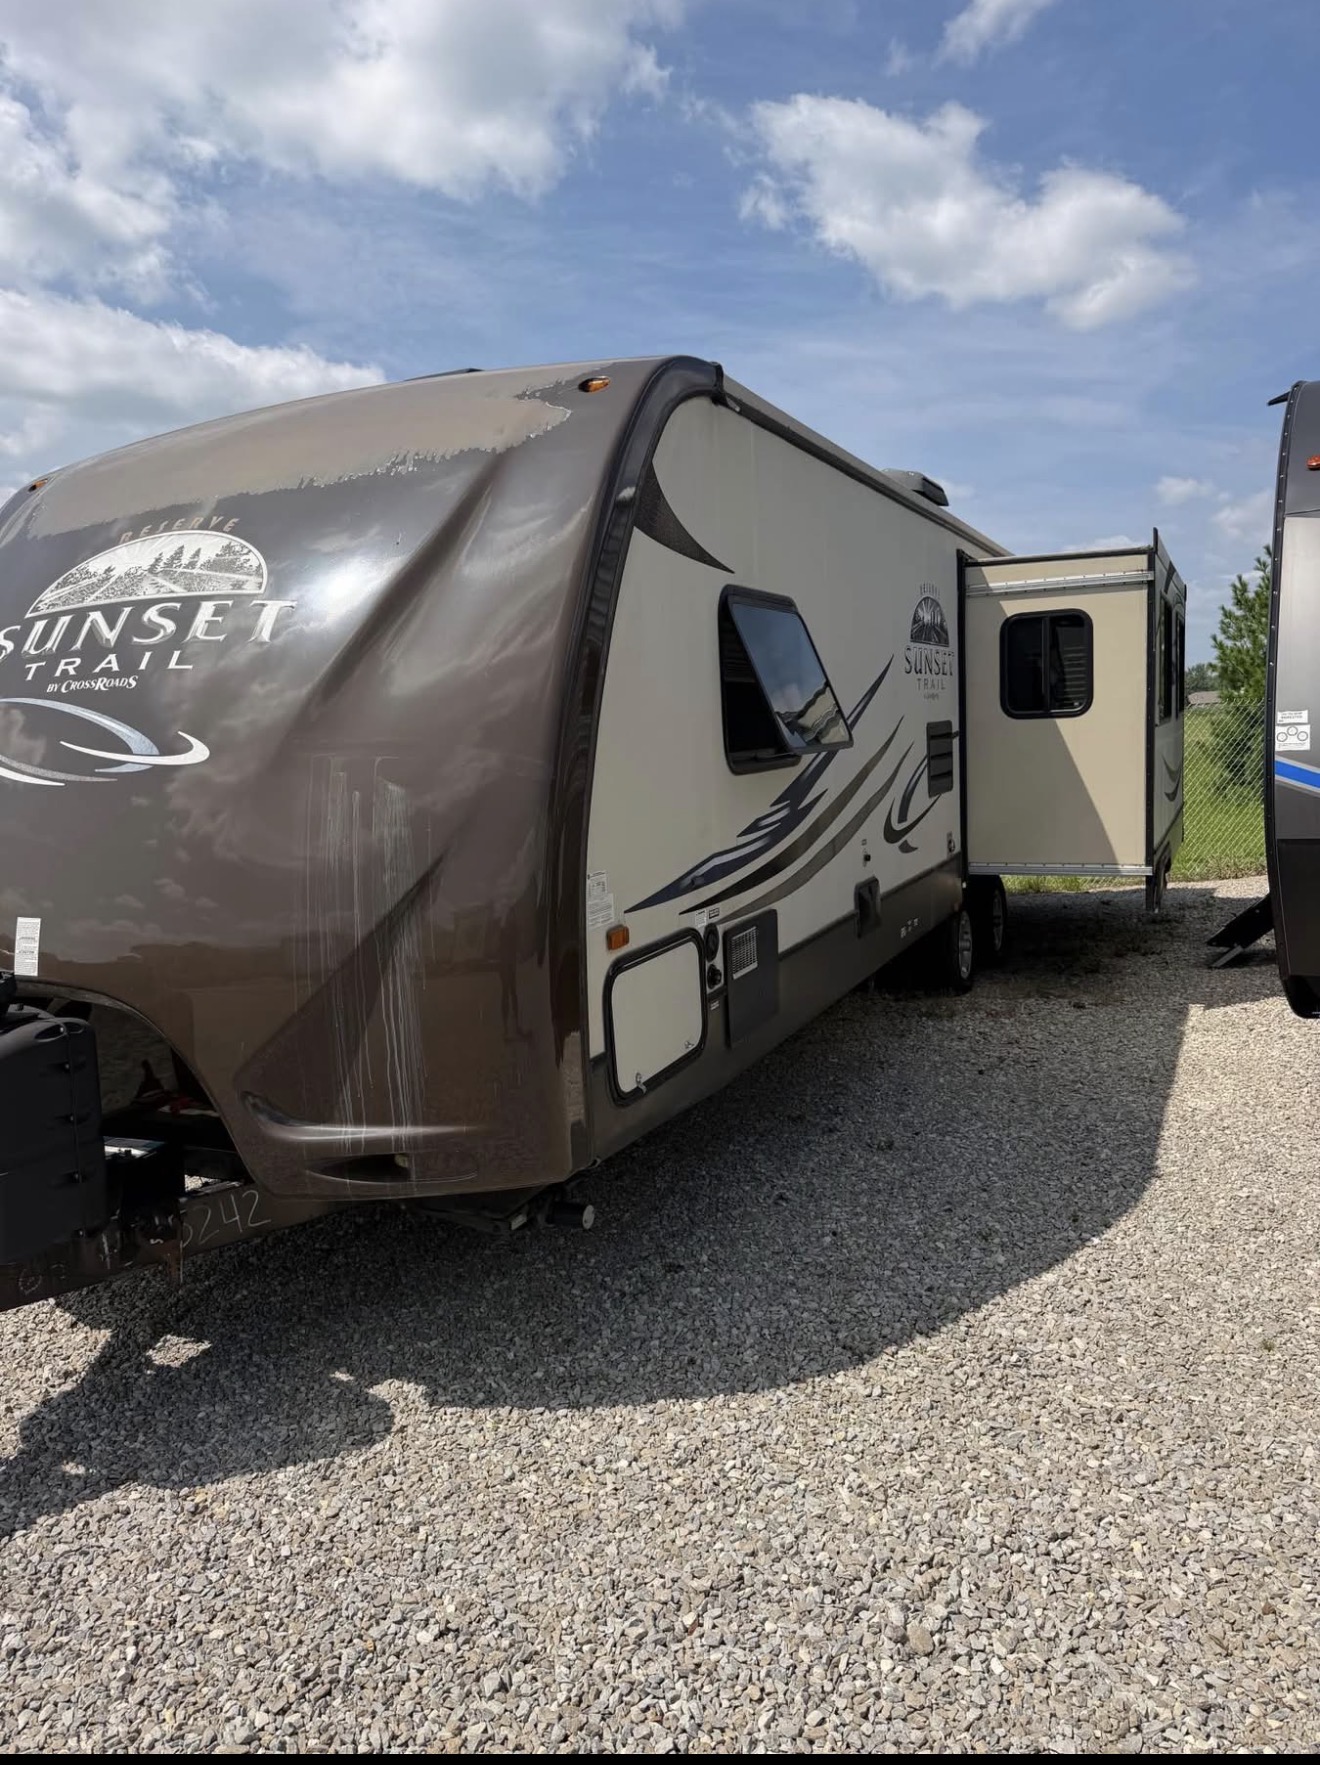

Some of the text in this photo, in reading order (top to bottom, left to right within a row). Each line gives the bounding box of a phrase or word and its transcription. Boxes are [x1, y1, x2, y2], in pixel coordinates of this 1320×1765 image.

[119, 516, 239, 544] RESERVE
[0, 600, 297, 661] SUNSET
[25, 651, 194, 681] TRAIL
[904, 645, 954, 676] SUNSET
[46, 683, 61, 693] BY
[917, 678, 946, 690] TRAIL
